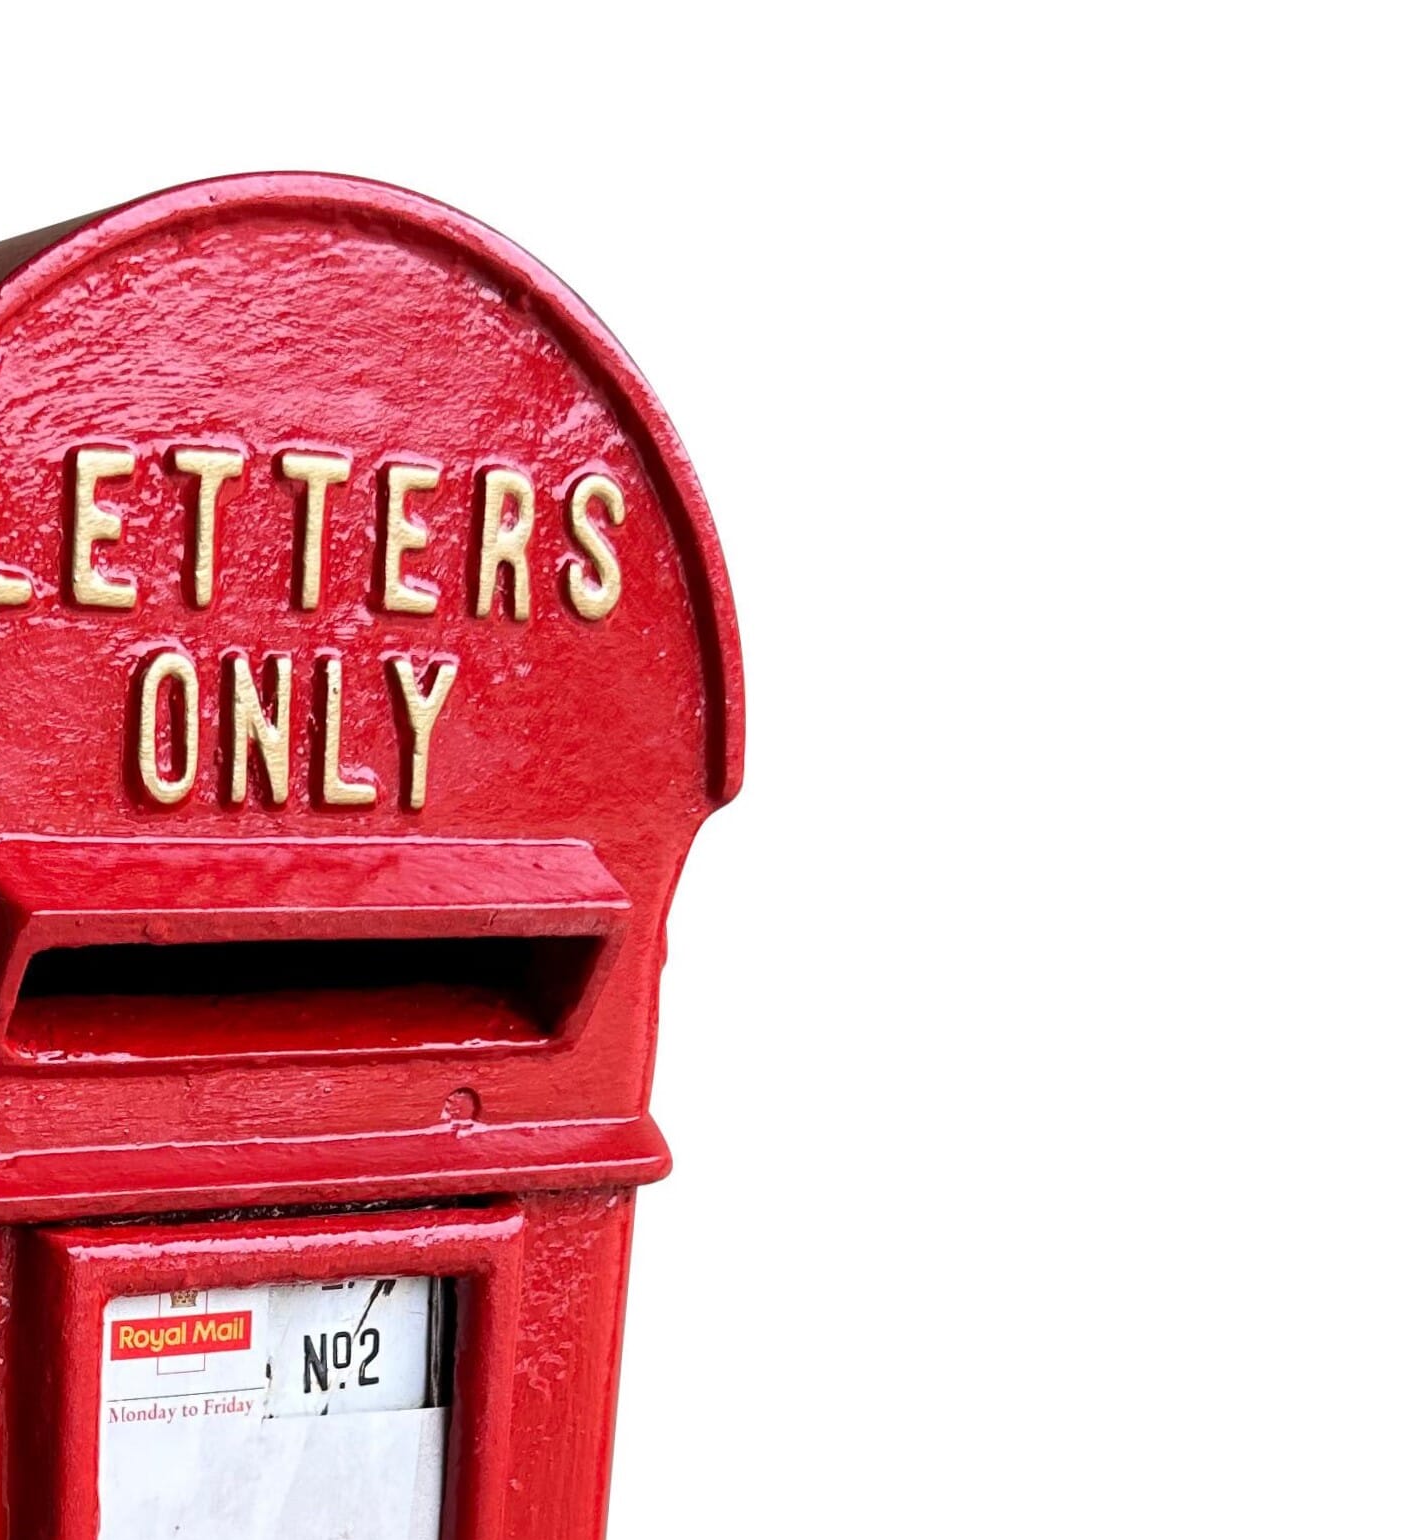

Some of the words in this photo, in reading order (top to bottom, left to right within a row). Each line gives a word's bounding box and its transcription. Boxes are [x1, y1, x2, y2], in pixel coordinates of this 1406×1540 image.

[140, 651, 458, 811] ONLY
[118, 1321, 187, 1353] Royal
[193, 1317, 244, 1342] Mail
[107, 1405, 177, 1425] Monday
[182, 1404, 199, 1417] to
[203, 1397, 254, 1417] Friday
